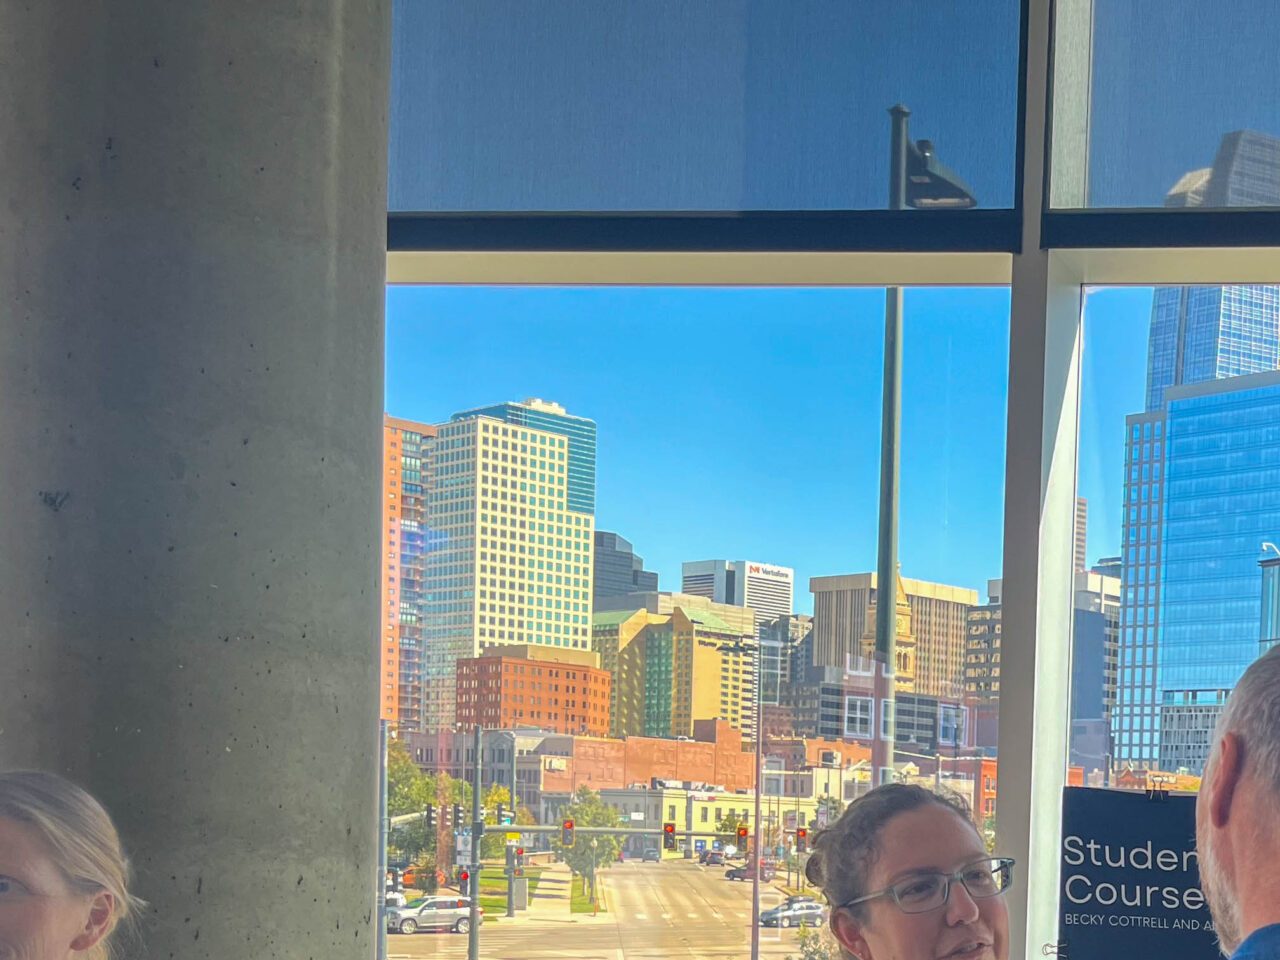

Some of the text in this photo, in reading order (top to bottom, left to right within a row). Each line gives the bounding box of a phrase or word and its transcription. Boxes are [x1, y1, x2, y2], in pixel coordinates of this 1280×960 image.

[1064, 836, 1198, 872] Studen
[1065, 914, 1105, 925] BECKY
[1109, 915, 1169, 929] COTTRELL
[1173, 919, 1200, 930] AND
